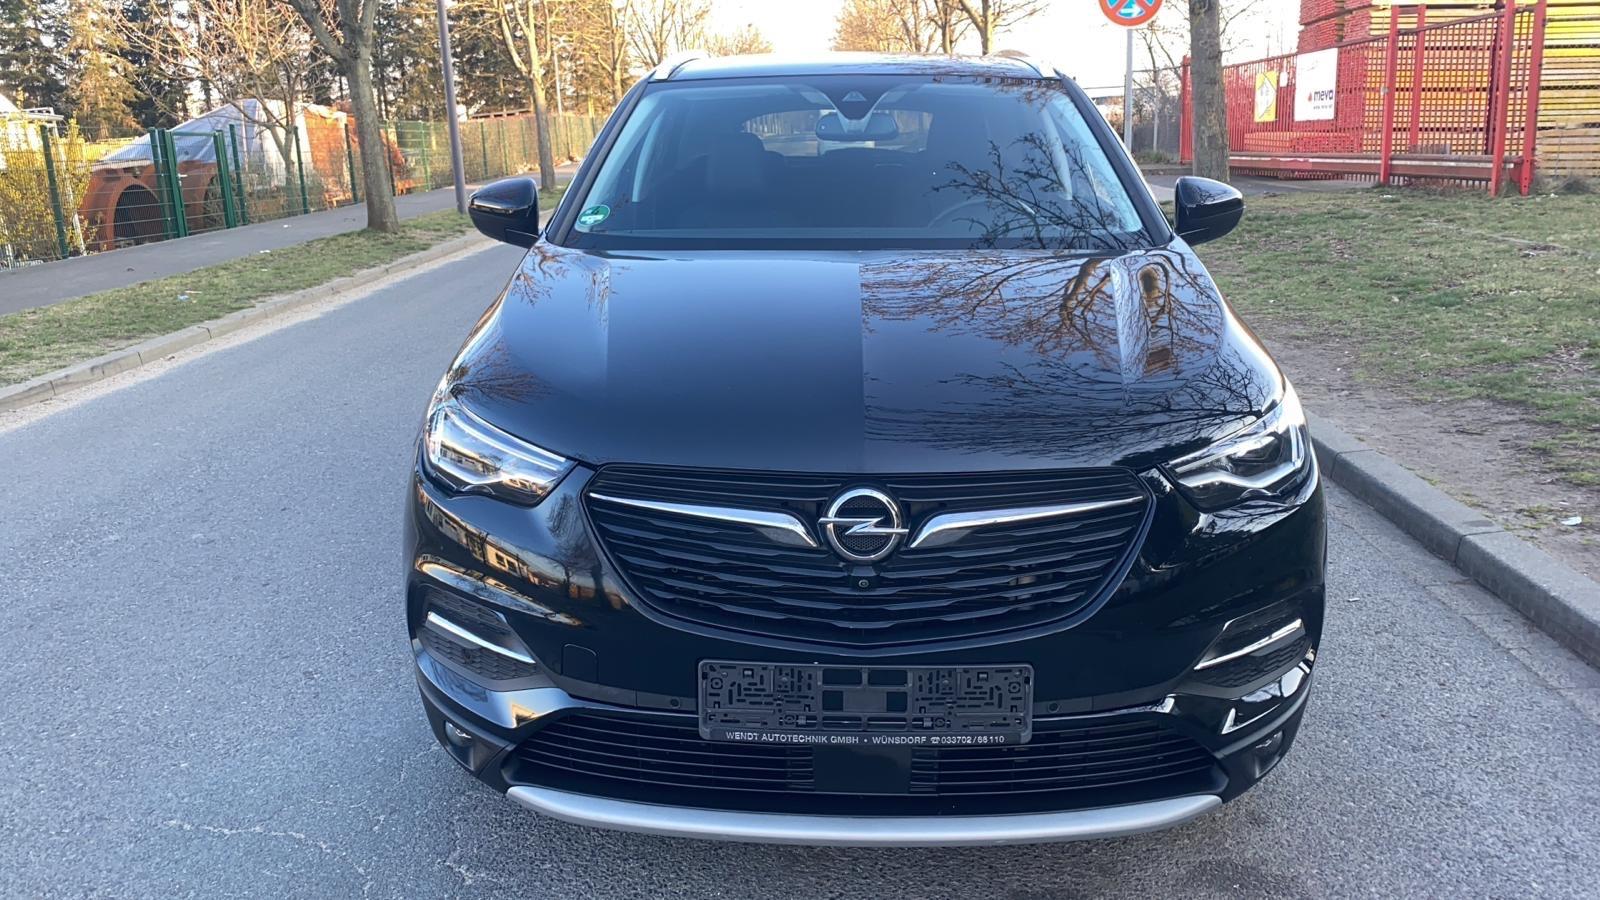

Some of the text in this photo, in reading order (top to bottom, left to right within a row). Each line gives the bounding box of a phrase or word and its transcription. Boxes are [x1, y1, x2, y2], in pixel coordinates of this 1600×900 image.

[726, 731, 759, 741] WENDT
[761, 733, 828, 743] AUTOTECHNIK
[830, 735, 859, 744] GMBH
[872, 735, 927, 744] WÜNSDORF
